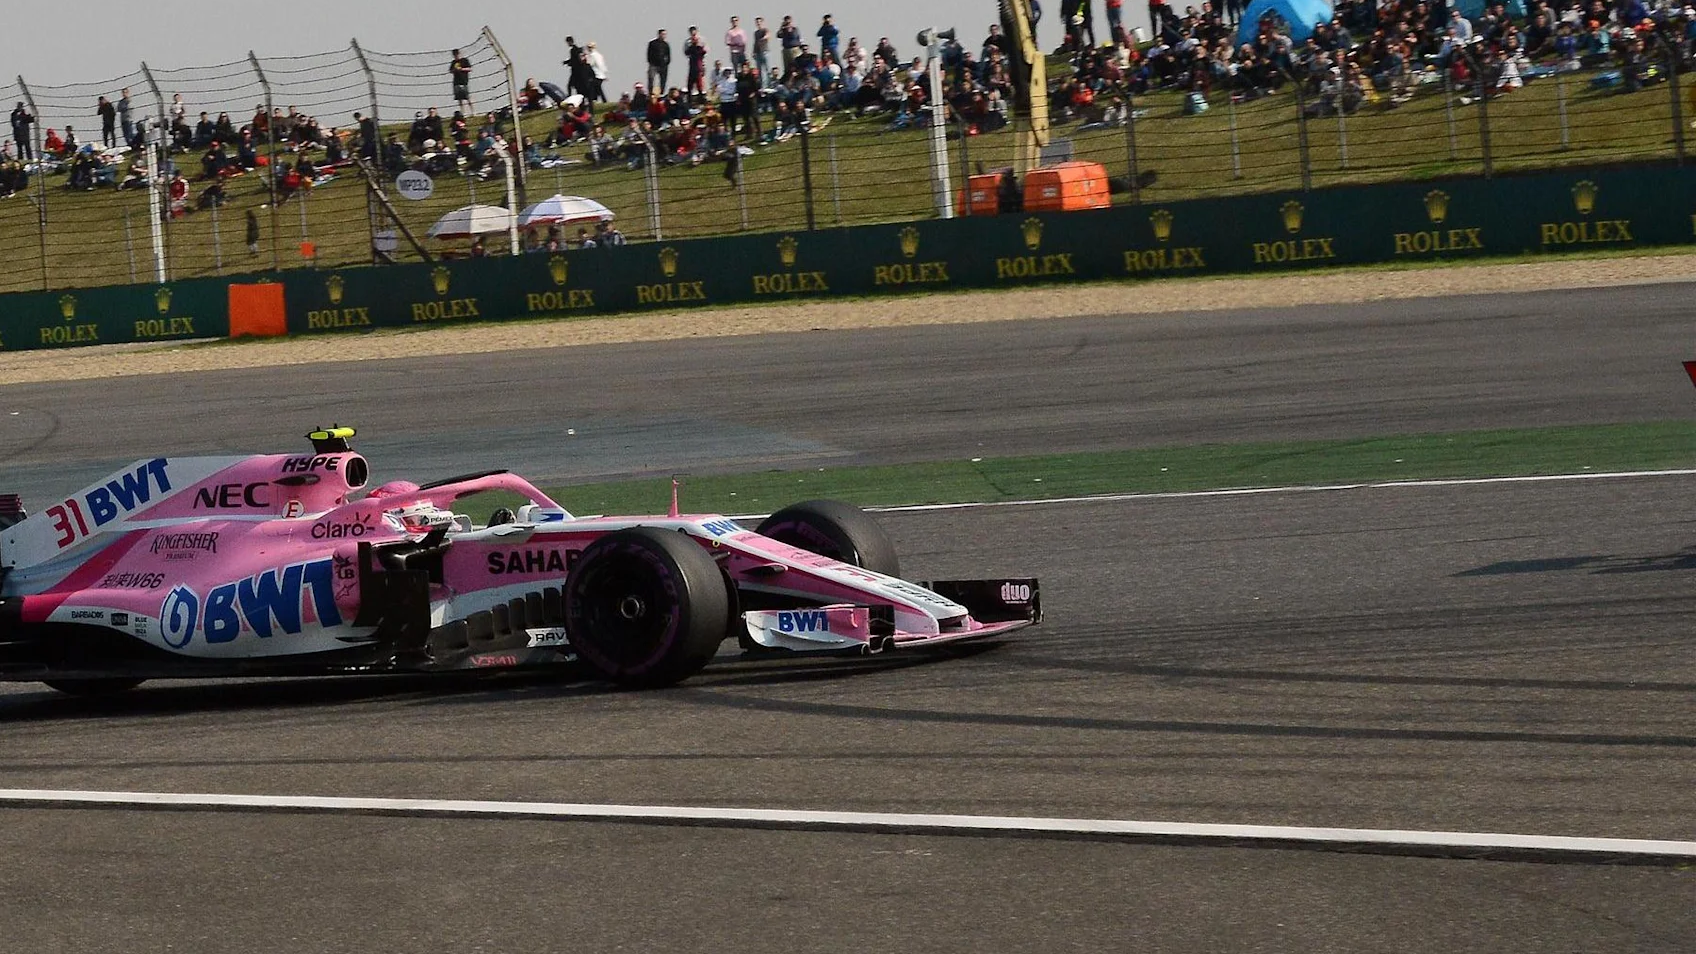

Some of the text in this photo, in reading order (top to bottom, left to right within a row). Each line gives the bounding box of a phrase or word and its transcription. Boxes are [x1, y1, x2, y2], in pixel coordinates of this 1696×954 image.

[1394, 228, 1483, 254] ROLEX
[1540, 220, 1633, 244] ROLEX
[1124, 247, 1205, 271] ROLEX
[1253, 238, 1335, 263] ROLEX
[874, 261, 949, 285] ROLEX
[996, 253, 1075, 278] ROLEX
[636, 281, 707, 304] ROLEX
[753, 271, 829, 294] ROLEX
[412, 298, 480, 321] ROLEX
[527, 289, 595, 311] ROLEX
[135, 317, 194, 337] ROLEX
[307, 307, 372, 329] ROLEX
[40, 324, 99, 344] ROLEX
[282, 457, 341, 472] HYPE
[46, 458, 172, 548] 31 BWT
[193, 482, 270, 509] NEC
[311, 516, 370, 539] Claro
[150, 532, 219, 553] KINGFISHER
[204, 559, 343, 644] BWT
[1001, 582, 1030, 600] duo
